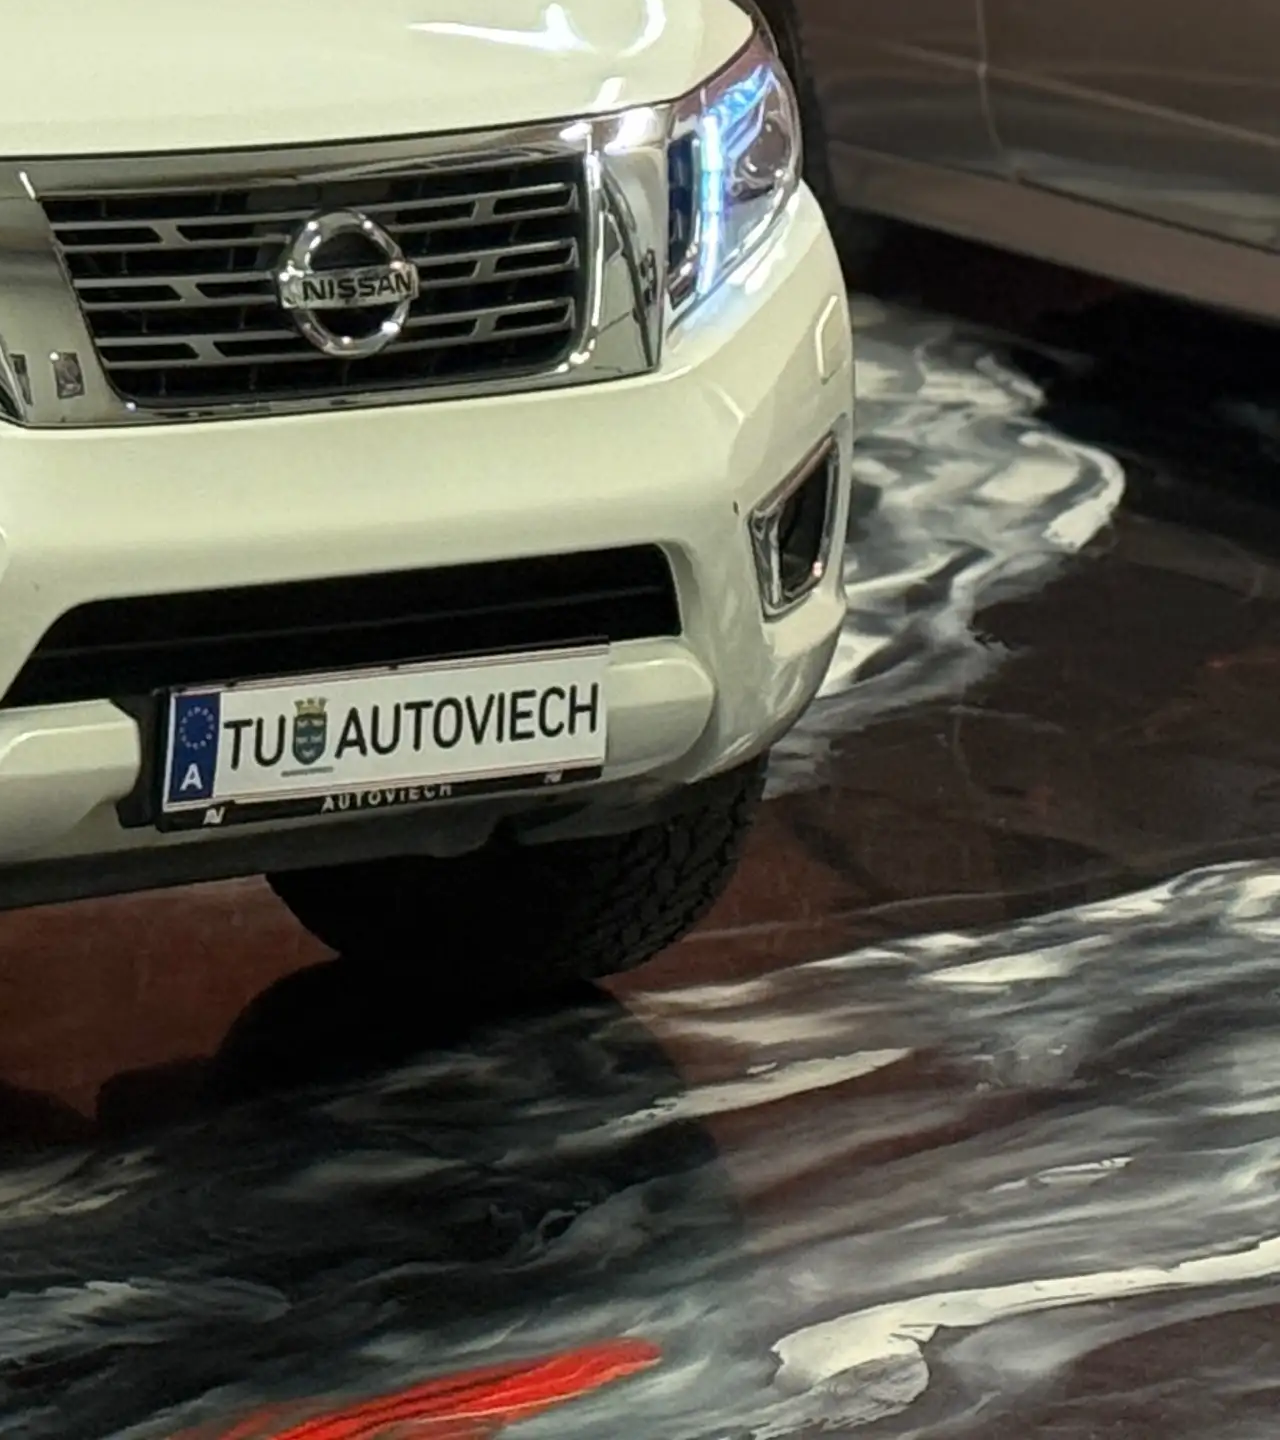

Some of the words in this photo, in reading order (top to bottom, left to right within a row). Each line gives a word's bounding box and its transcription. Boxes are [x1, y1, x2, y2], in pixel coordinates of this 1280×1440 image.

[302, 272, 413, 302] NISSAN
[224, 714, 286, 770] TU
[335, 682, 599, 760] AUTOVIECH
[180, 762, 203, 791] A
[321, 783, 453, 814] AUTOVIECH
